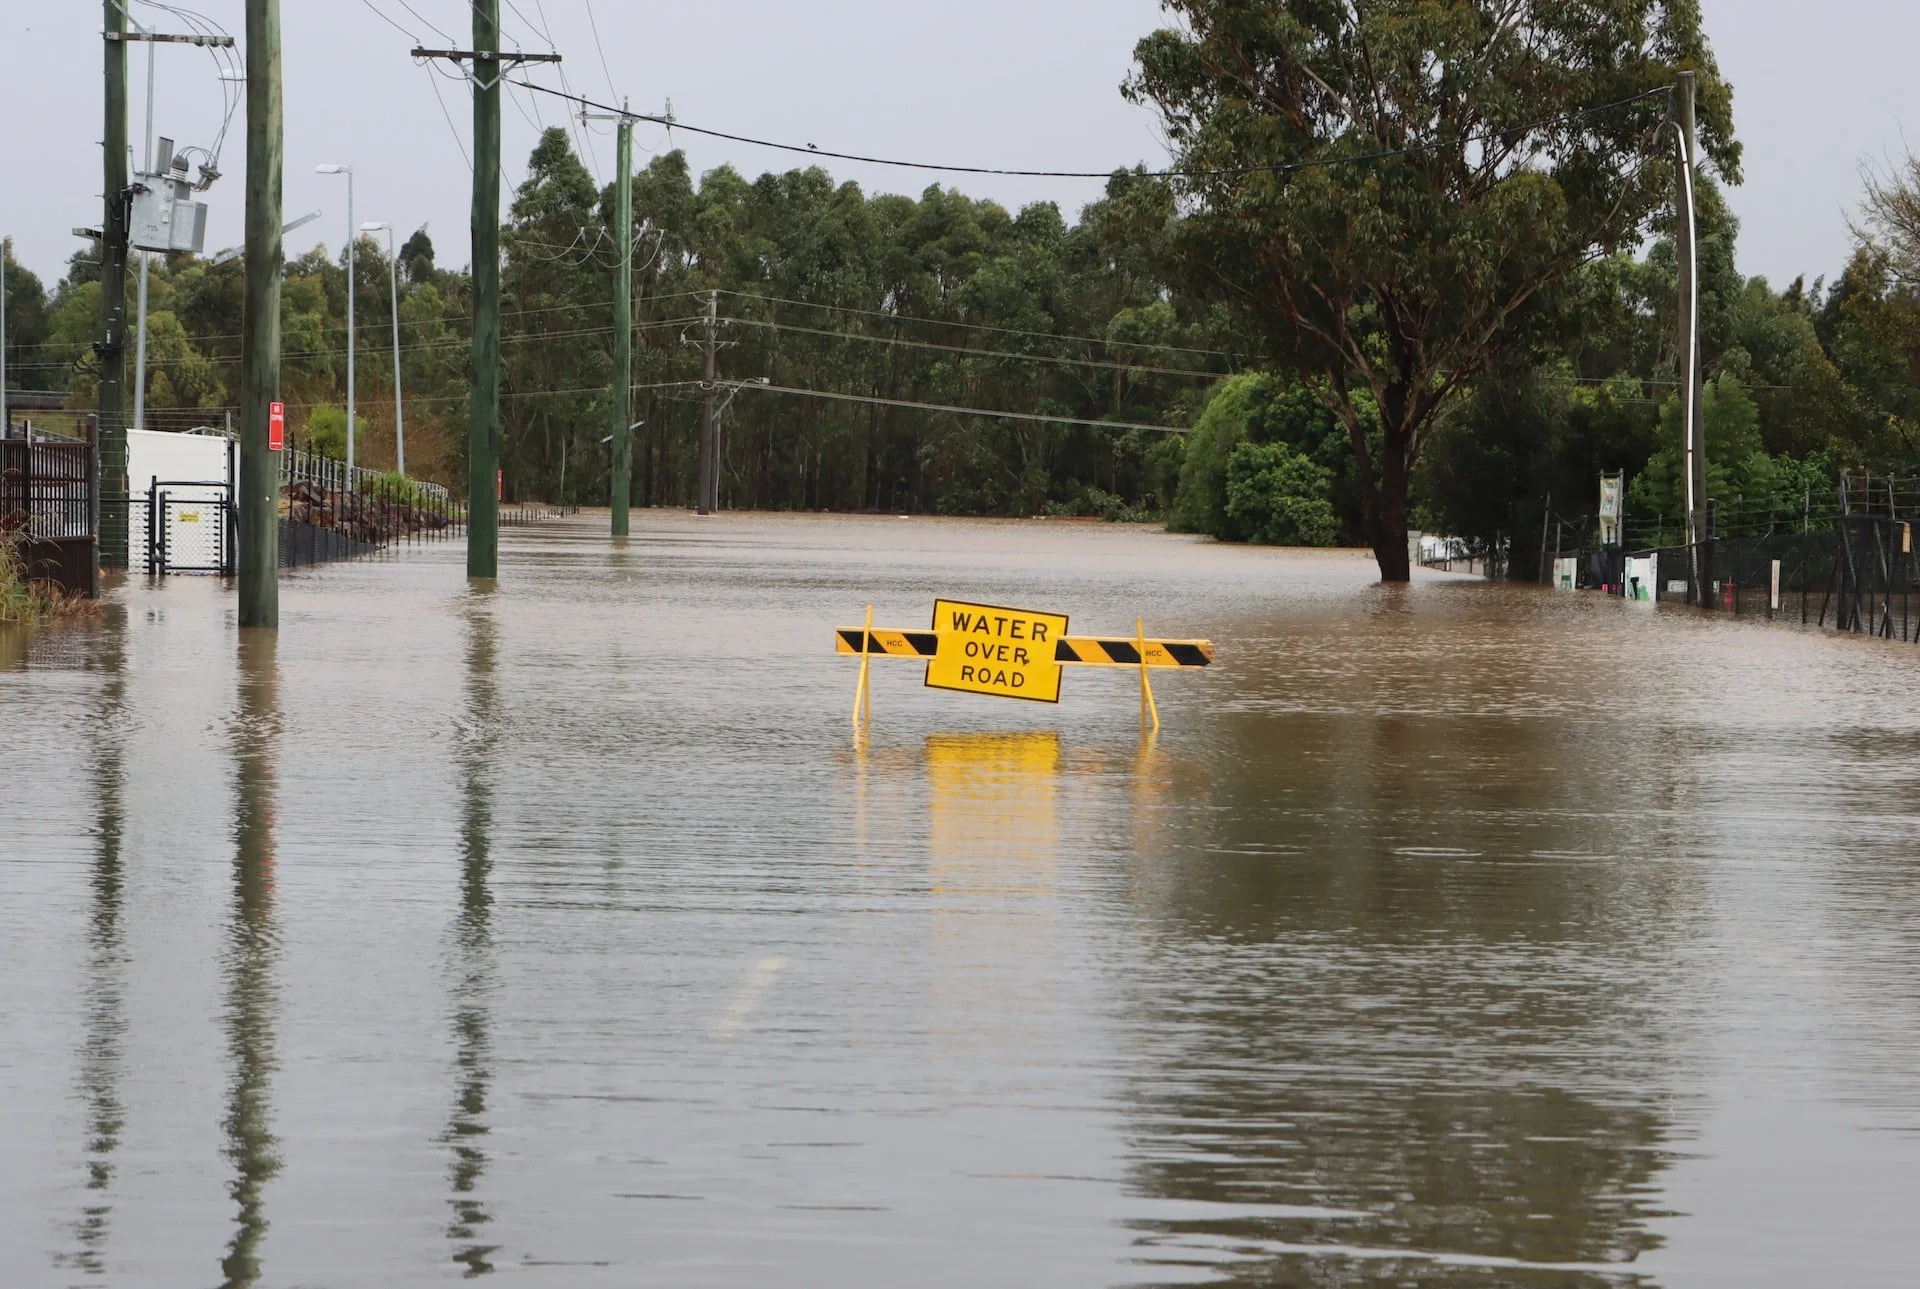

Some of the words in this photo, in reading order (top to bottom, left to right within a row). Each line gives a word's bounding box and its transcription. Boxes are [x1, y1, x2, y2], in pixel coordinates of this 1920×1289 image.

[952, 611, 1048, 642] WATER
[886, 639, 903, 647] HCC
[965, 641, 1029, 666] OVER
[961, 665, 1025, 688] ROAD
